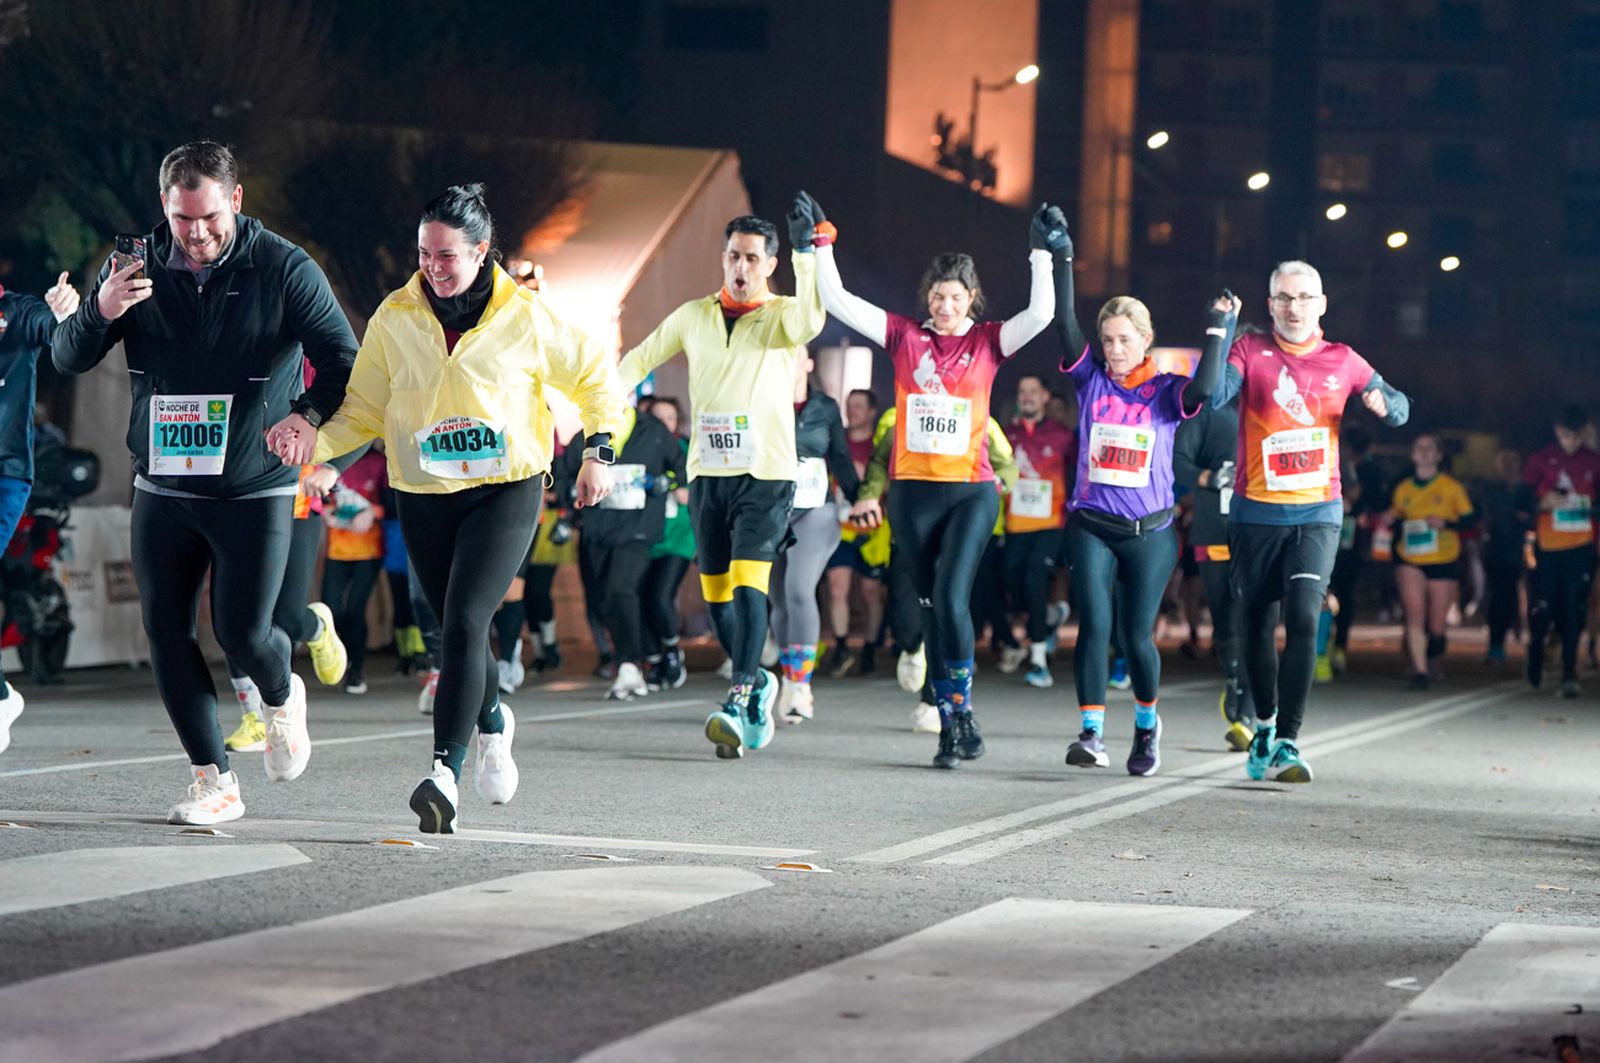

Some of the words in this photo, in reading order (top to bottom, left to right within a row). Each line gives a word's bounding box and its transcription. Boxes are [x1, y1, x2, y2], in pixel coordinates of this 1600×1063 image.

[160, 413, 172, 422] SAN
[173, 411, 200, 422] ANTÓN
[166, 404, 188, 412] NOCHE
[190, 404, 200, 412] DE
[919, 416, 957, 434] 1868
[160, 424, 223, 448] 12006
[427, 428, 498, 453] 14034
[708, 433, 741, 449] 1867
[1099, 444, 1137, 466] 9780
